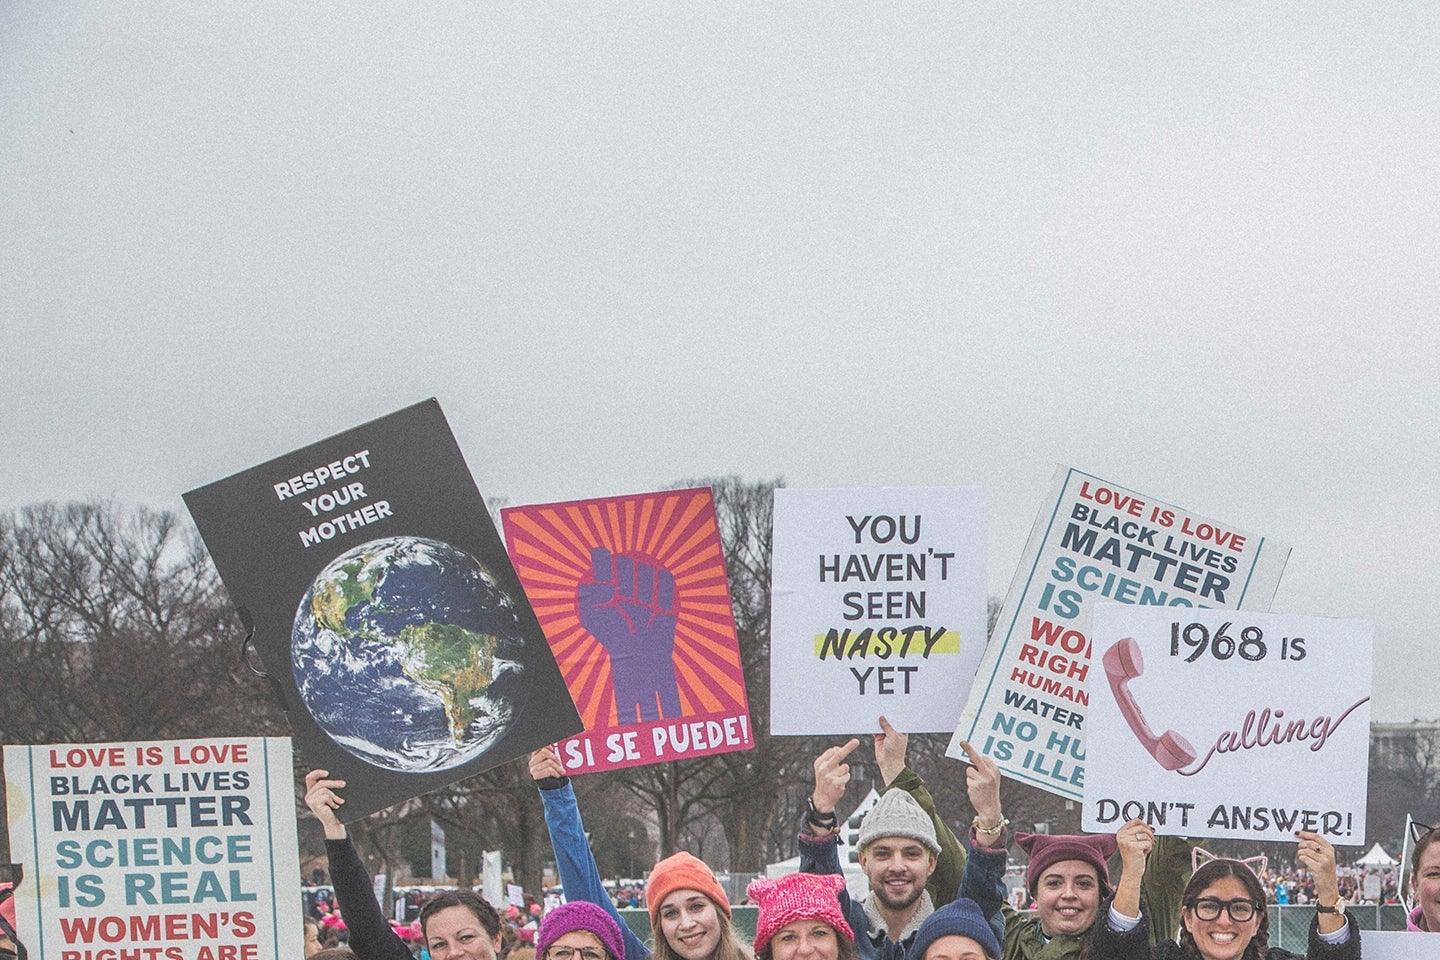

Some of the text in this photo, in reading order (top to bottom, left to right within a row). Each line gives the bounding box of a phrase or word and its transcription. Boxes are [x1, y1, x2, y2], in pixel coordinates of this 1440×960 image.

[274, 450, 370, 500] RESPECT
[302, 482, 367, 516] YOUR
[1079, 481, 1246, 553] LOVE IS LOVE
[299, 500, 394, 548] MOTHER
[845, 515, 921, 544] YOU
[1071, 502, 1238, 574] BLACK LIVES
[819, 547, 955, 582] HAVEN'T
[1060, 522, 1231, 603] MATTER
[1038, 582, 1083, 619] IS
[1051, 556, 1212, 608] SCIEN
[843, 591, 926, 620] SEEN
[819, 625, 947, 661] NASTY
[1030, 616, 1092, 660] WO
[1170, 622, 1307, 663] 1968 IS
[850, 666, 918, 695] YET
[1019, 643, 1089, 682] RIGH
[1010, 667, 1089, 707] HUMAN
[992, 711, 1038, 742] NO
[1004, 689, 1084, 730] WATER
[50, 745, 248, 768] LOVE IS LOVE
[606, 731, 640, 762] SE
[652, 715, 749, 756] PUEDE!
[982, 735, 1085, 788] IS ILLE
[50, 771, 250, 795] BLACK LIVES
[52, 796, 253, 831] MATTER
[1096, 799, 1352, 836] DON'T ANSWER!
[56, 835, 252, 869] SCIENCE
[57, 870, 257, 907] IS REAL
[60, 911, 256, 944] WOMEN'S
